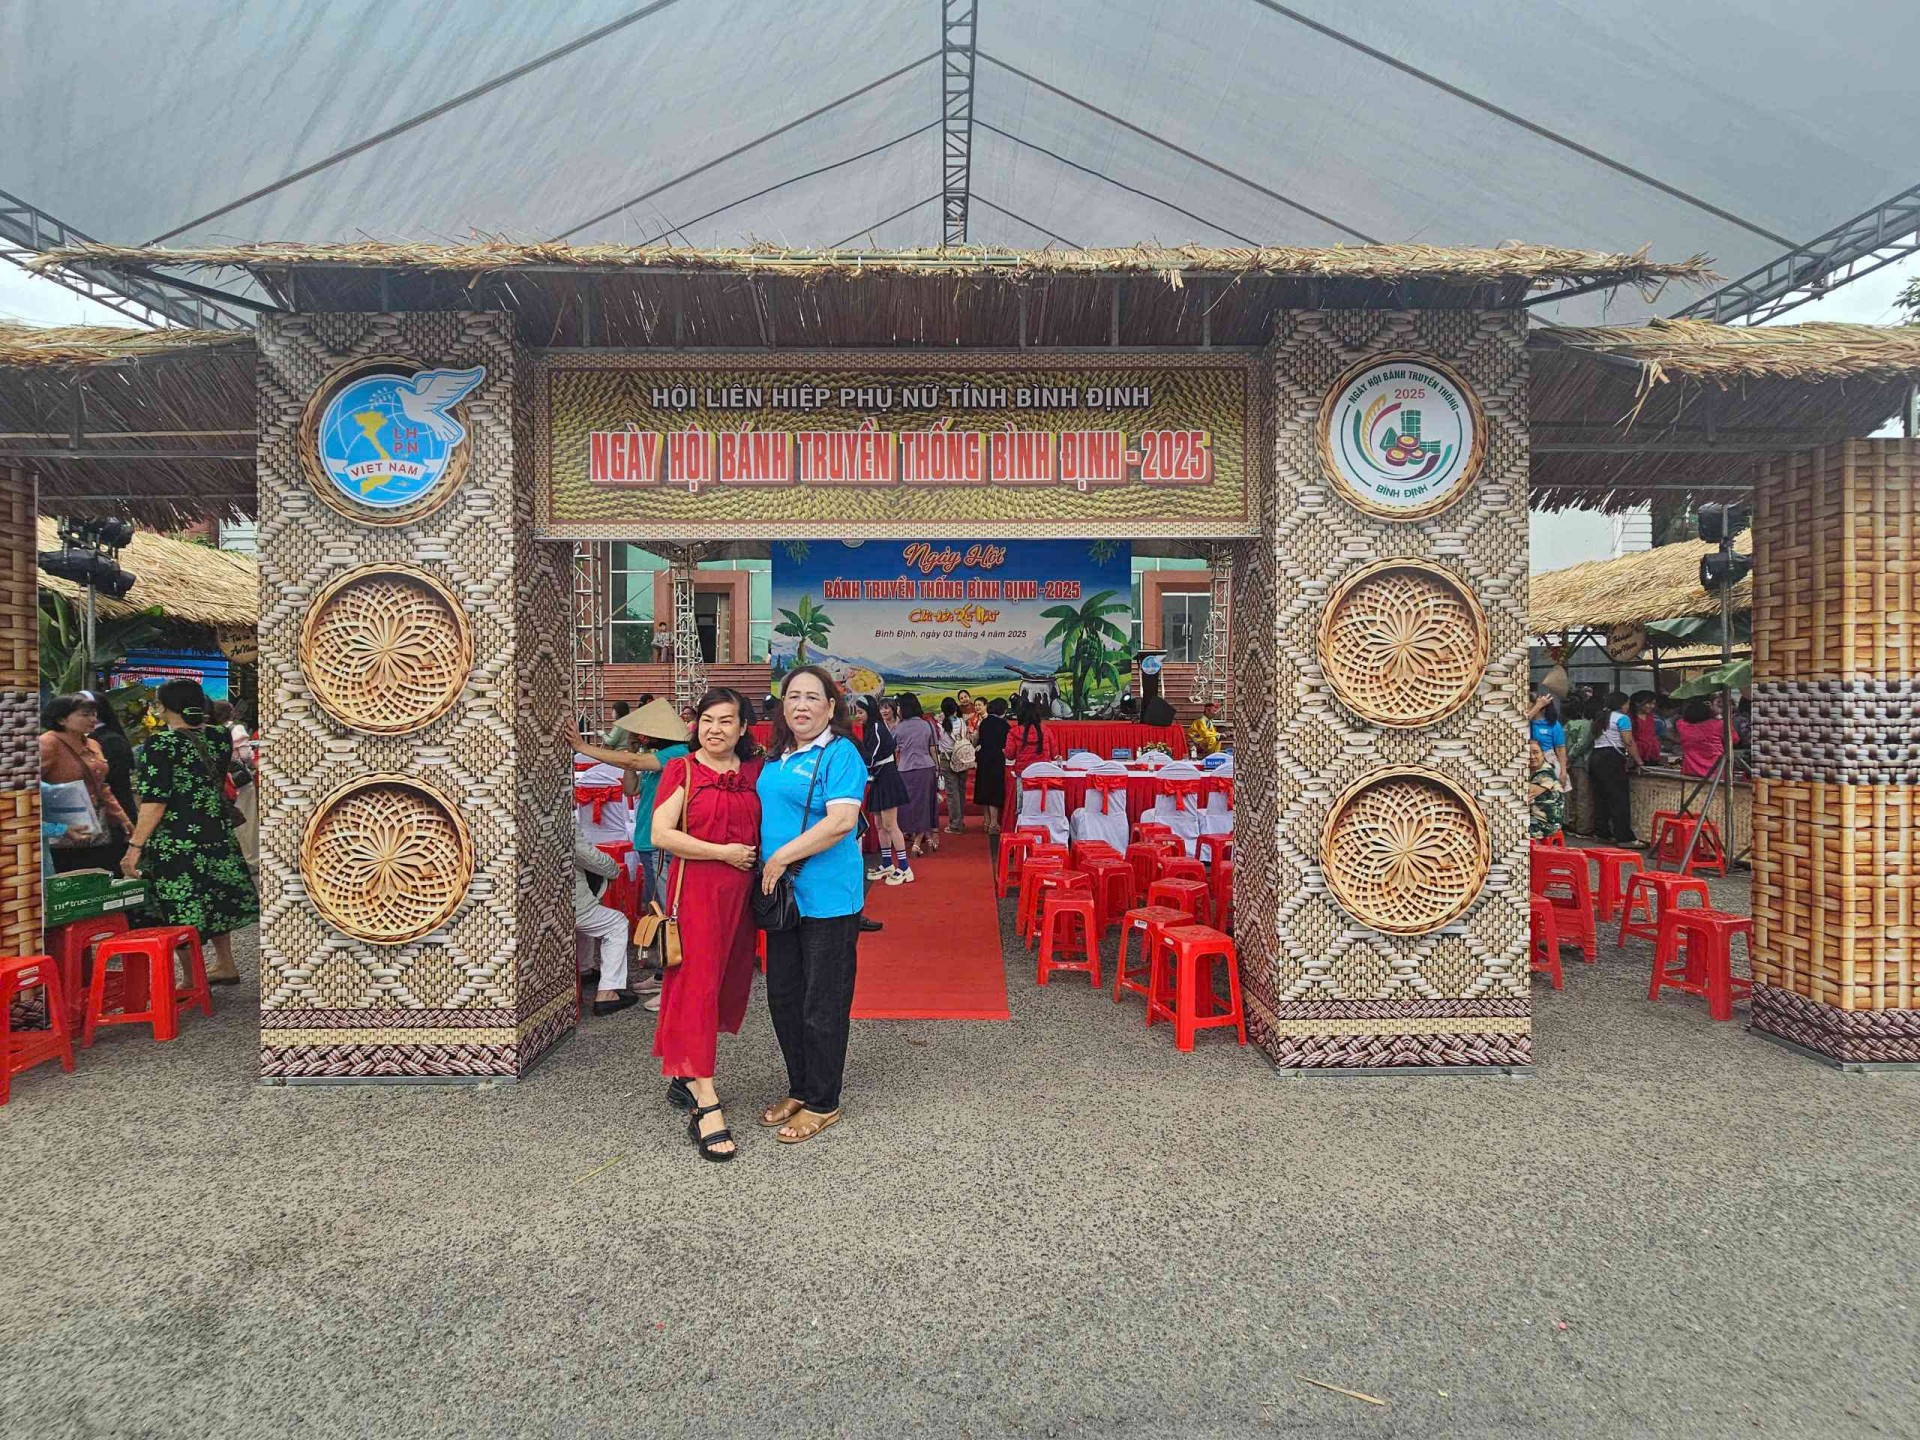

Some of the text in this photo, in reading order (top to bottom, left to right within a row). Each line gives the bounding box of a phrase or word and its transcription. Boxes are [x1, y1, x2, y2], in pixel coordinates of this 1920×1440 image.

[652, 382, 1150, 412] HỘI LIÊN HIỆP PHỤ NỮ TỈNH BÌNH ĐỊNH
[1394, 388, 1426, 400] 2025
[590, 423, 658, 482] NGÀY
[668, 423, 713, 492] HỘI
[720, 422, 789, 482] BÁNH
[798, 417, 892, 482] TRUYỀN
[899, 417, 982, 482] THỐNG
[991, 422, 1053, 482] BÌNH
[388, 462, 419, 476] NAM
[1375, 484, 1429, 498] BÌNH ĐỊNH
[903, 543, 1006, 574] Ngày Hội
[824, 576, 862, 600] BÁNH
[863, 575, 916, 600] TRUYỀN
[918, 574, 963, 600] THỐNG
[966, 576, 1000, 600] BÌNH
[875, 629, 1027, 640] Bình Định, ngày 03 tháng 4 năm 2025
